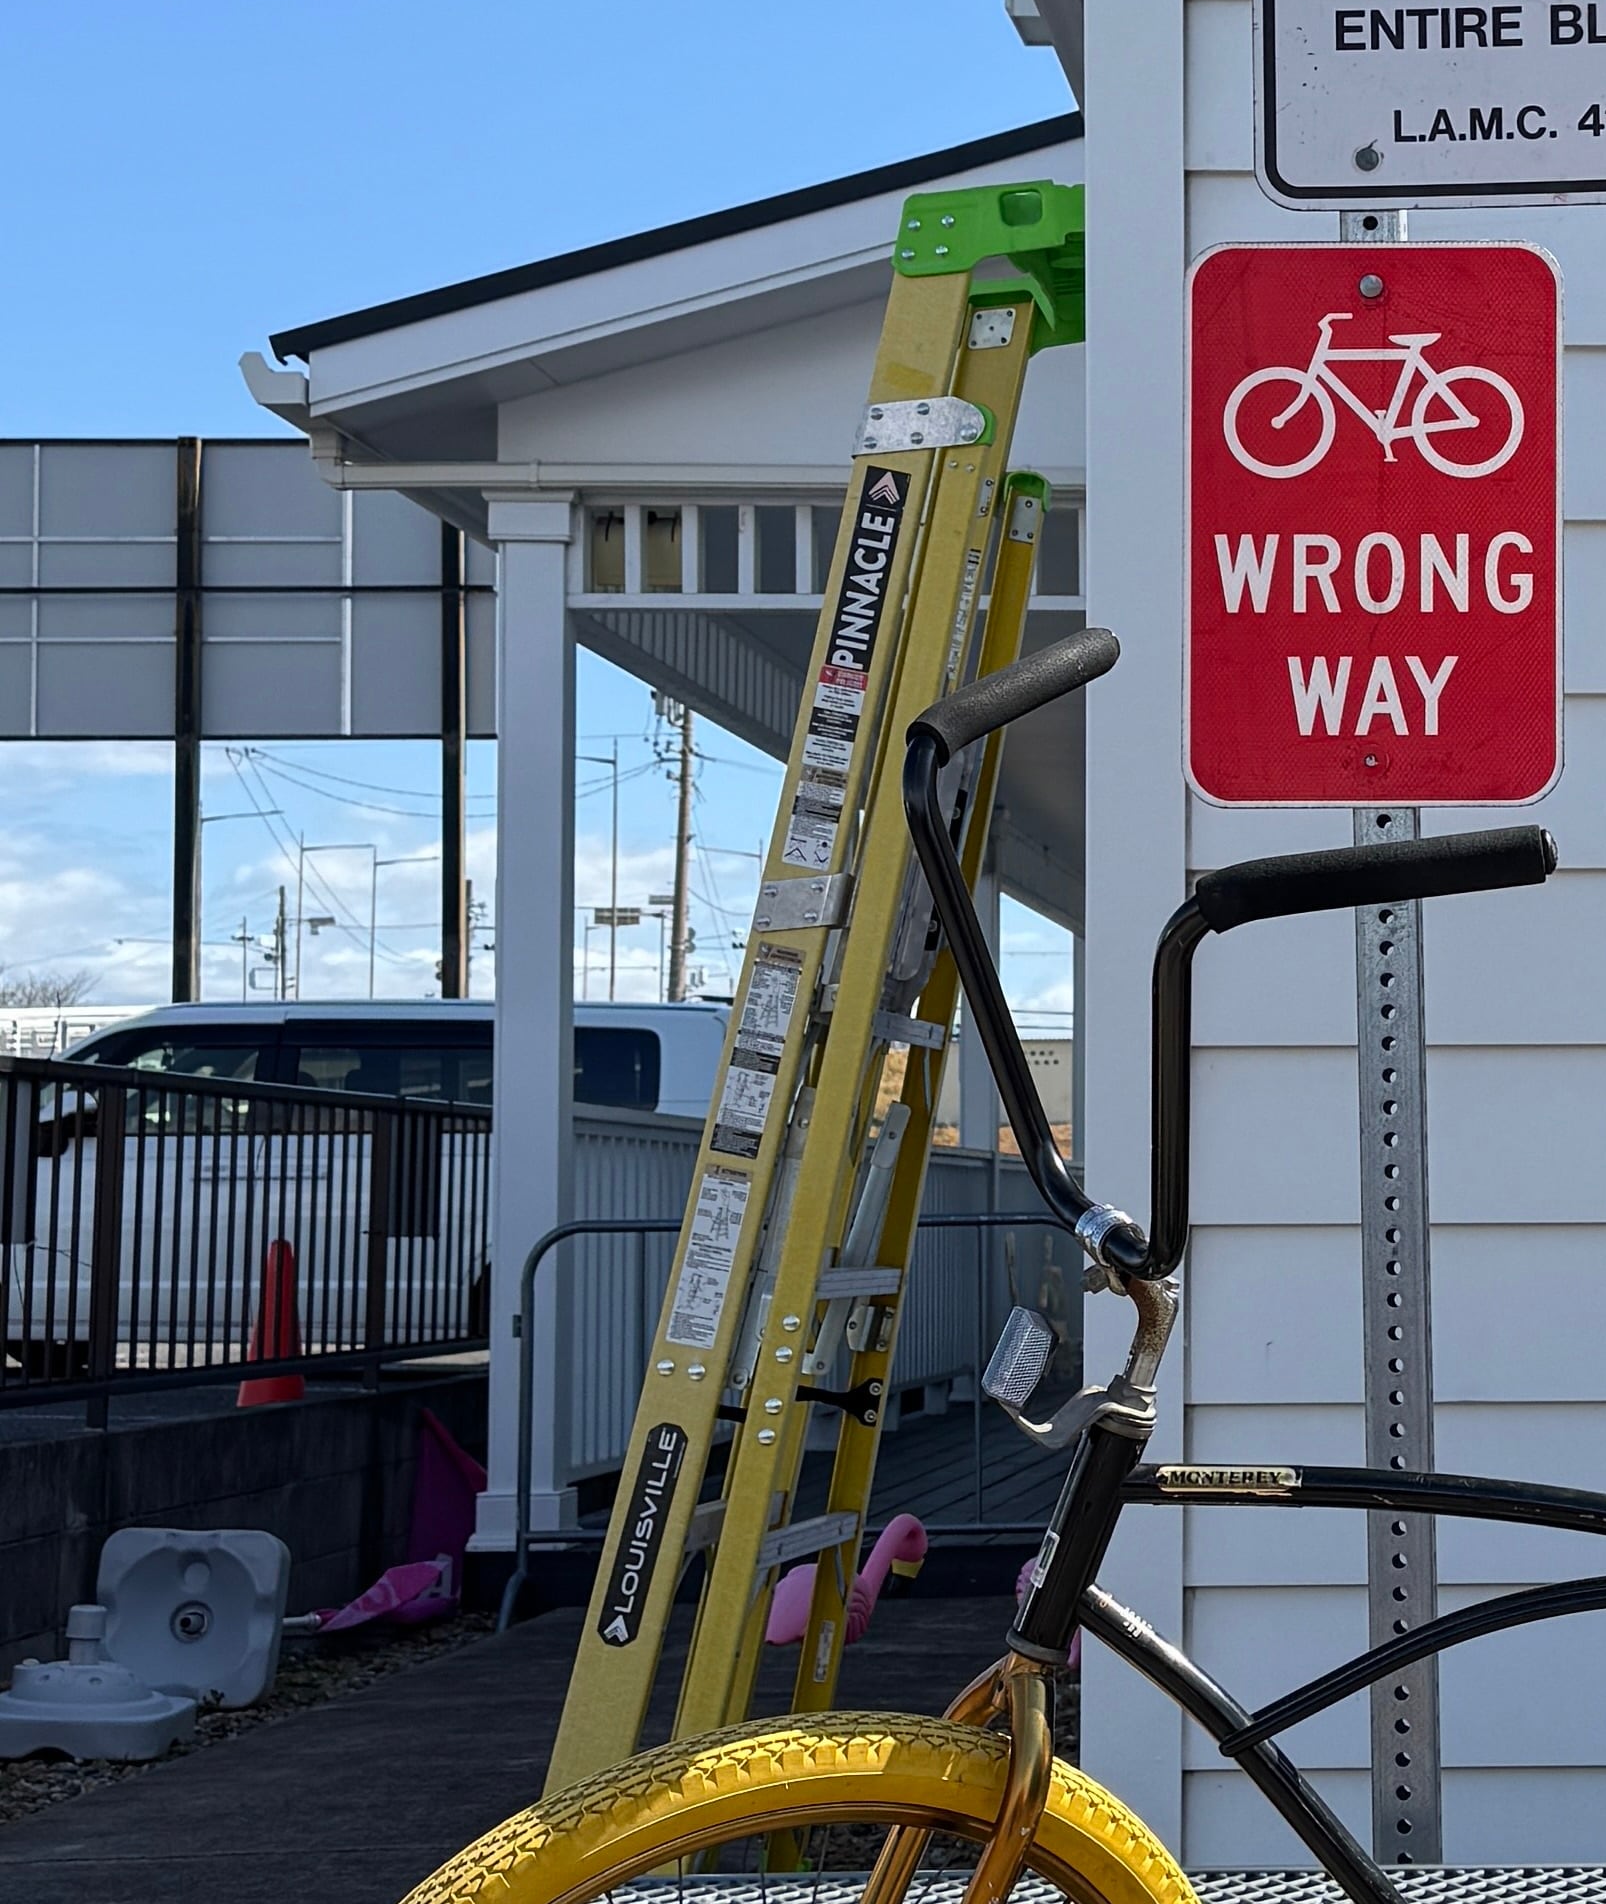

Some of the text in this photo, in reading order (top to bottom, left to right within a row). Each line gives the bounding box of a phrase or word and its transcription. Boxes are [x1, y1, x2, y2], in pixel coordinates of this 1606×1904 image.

[1335, 5, 1523, 51] ENTIRE
[1393, 104, 1558, 143] L.A.M.C.
[831, 511, 896, 671] PINNACLE
[1213, 531, 1535, 615] WRONG
[1286, 655, 1460, 737] WAY
[1170, 1471, 1281, 1486] MONTEREY
[614, 1427, 678, 1614] LOUISVILLE
